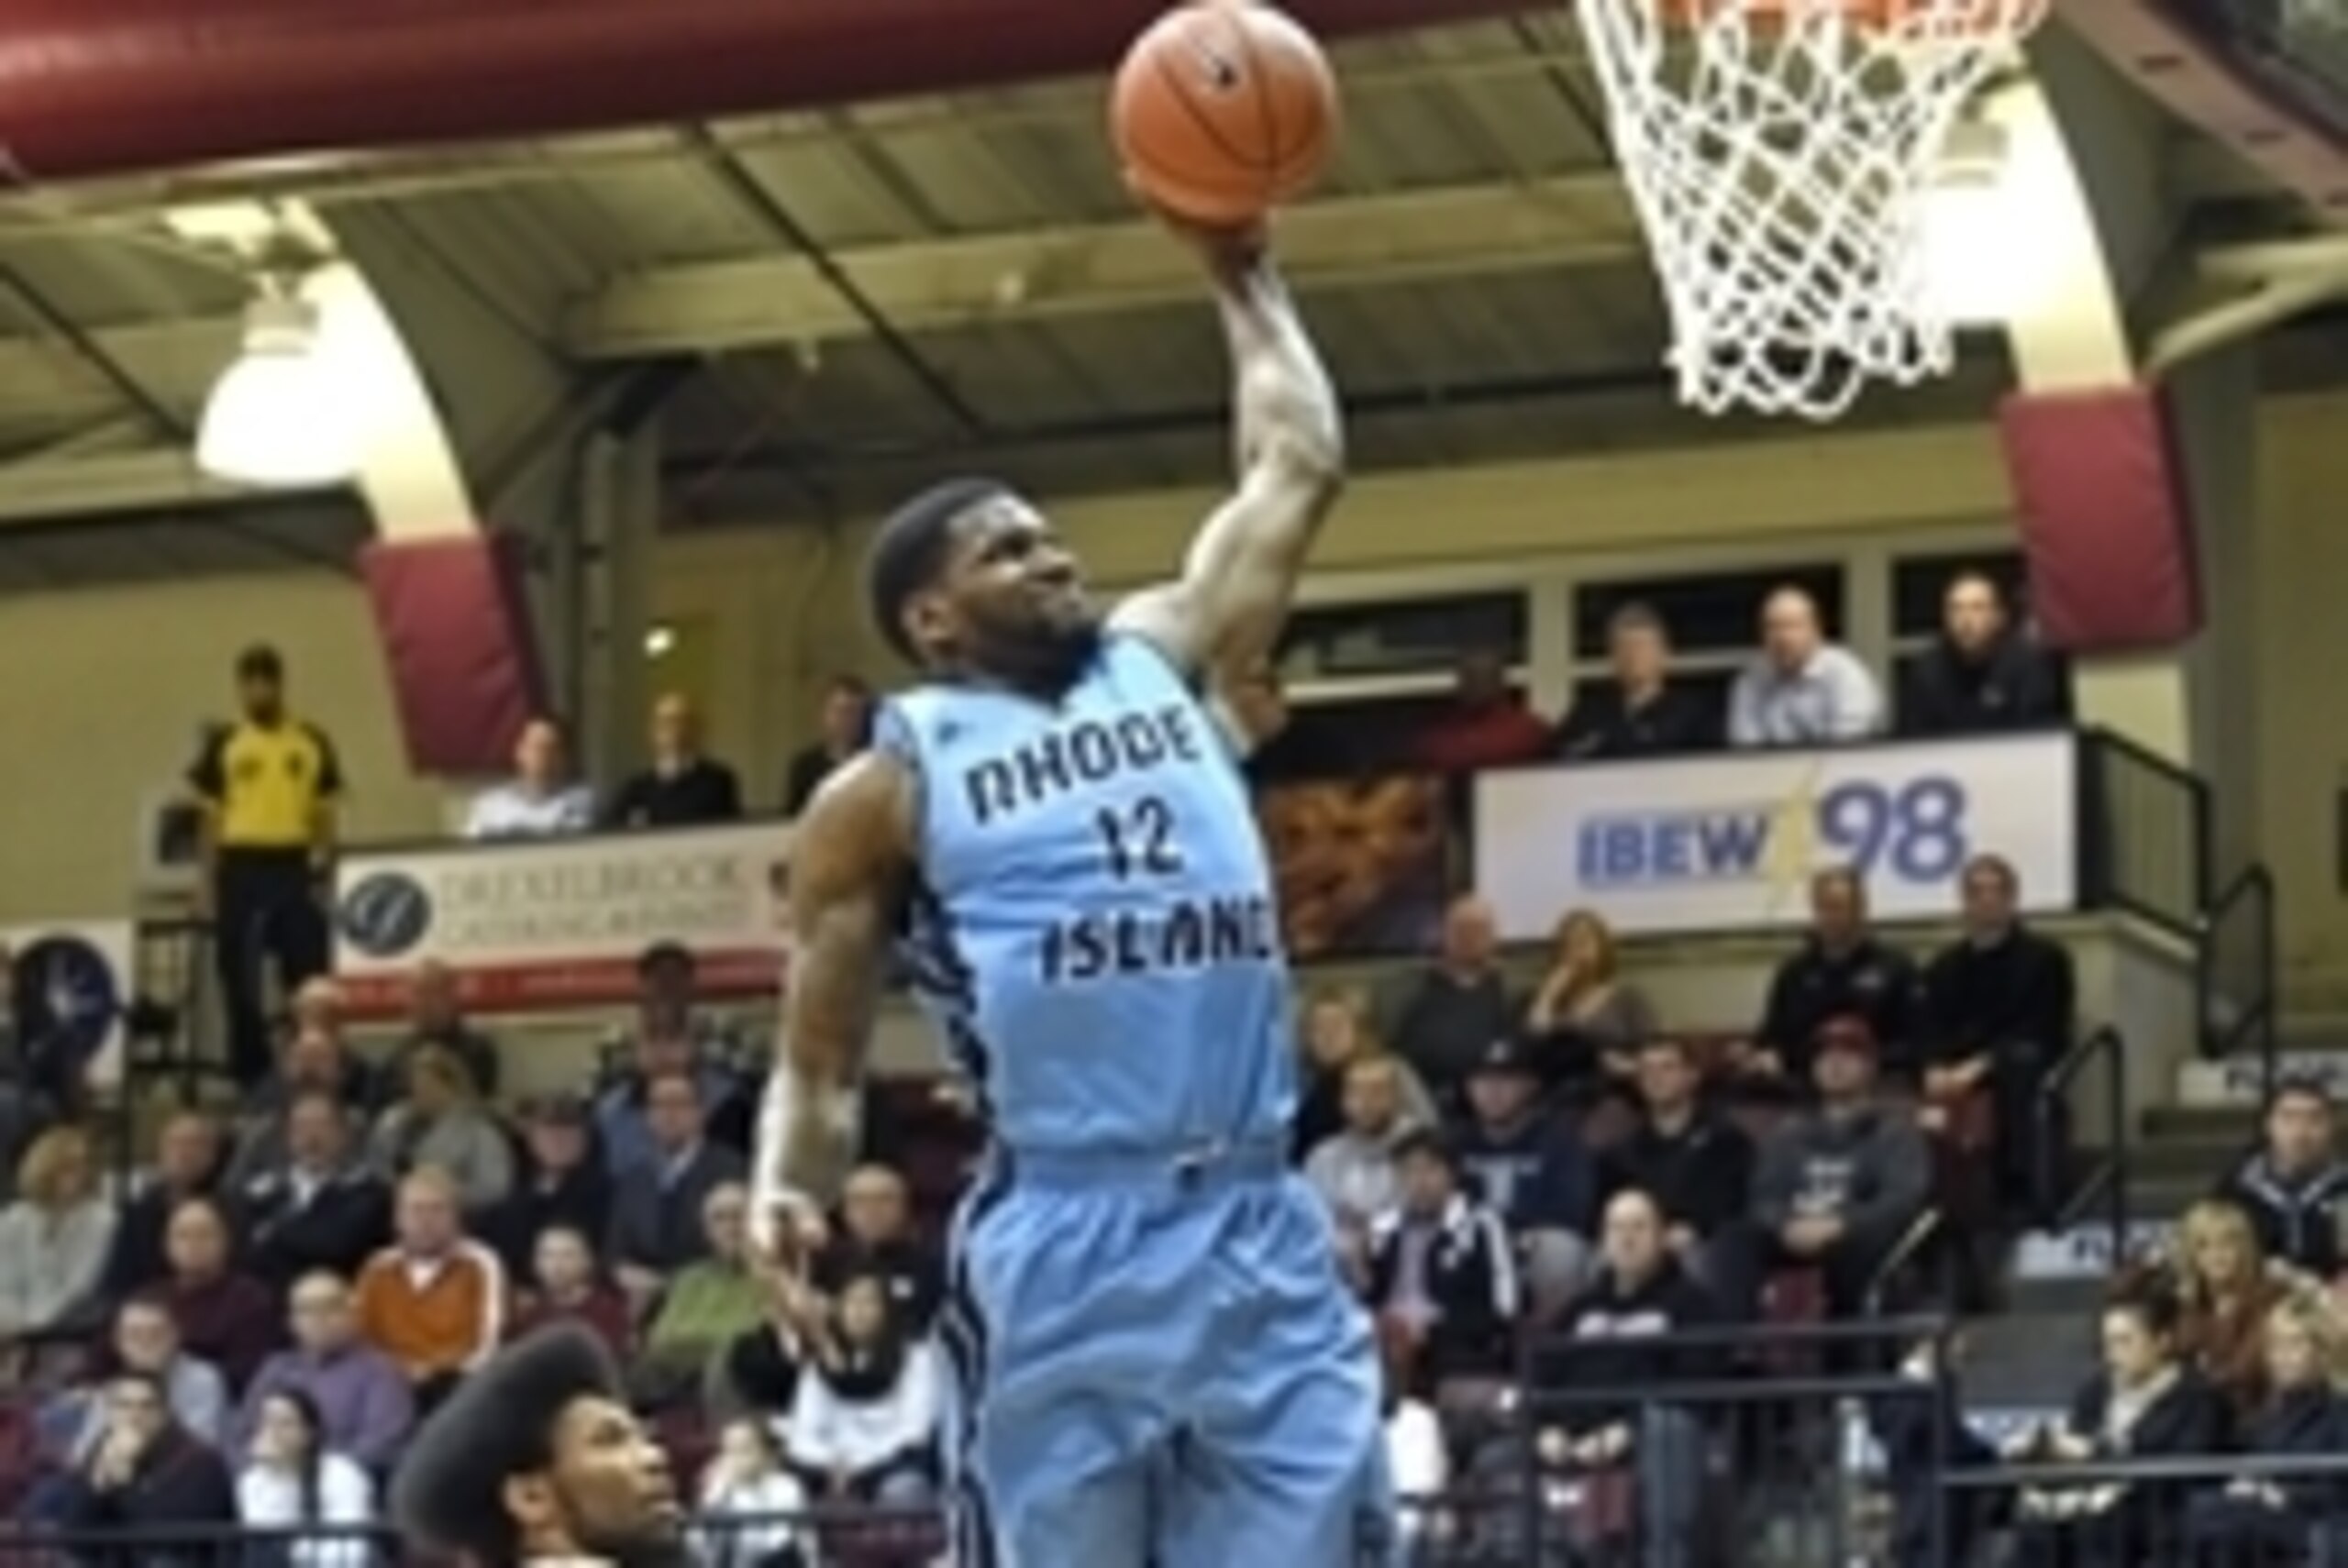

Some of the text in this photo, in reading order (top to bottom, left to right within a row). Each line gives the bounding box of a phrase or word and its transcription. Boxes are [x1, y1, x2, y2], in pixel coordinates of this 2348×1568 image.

[964, 704, 1202, 824] RHODE
[1096, 796, 1183, 880] 12
[1576, 775, 1968, 888] IBEW 98
